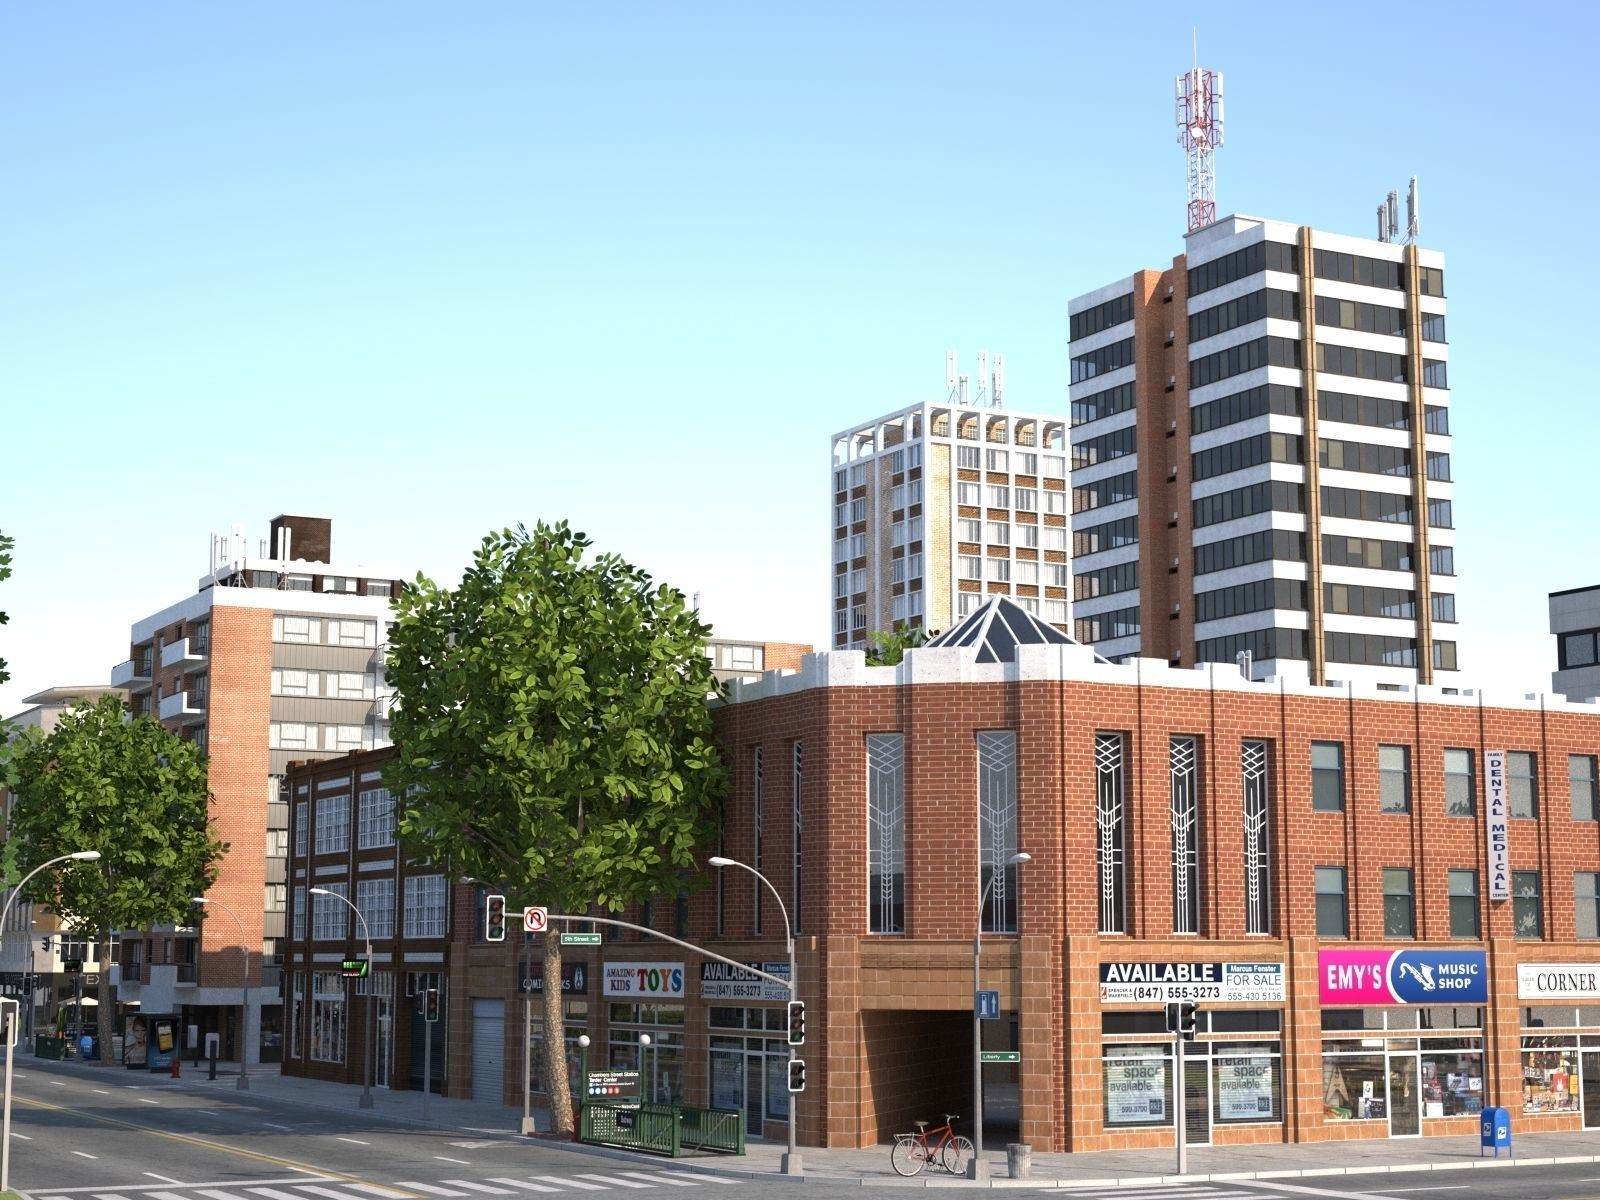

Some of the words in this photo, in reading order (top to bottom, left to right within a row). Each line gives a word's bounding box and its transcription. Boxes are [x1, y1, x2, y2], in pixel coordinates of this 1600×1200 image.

[1490, 760, 1503, 816] DENTAL
[1492, 824, 1506, 890] MEDICAL
[606, 968, 635, 978] AMAZING
[703, 963, 758, 981] AVAILABLE
[1106, 963, 1215, 982] AVAILABLE
[1230, 965, 1252, 973] Marcus
[1438, 964, 1478, 974] MUSIC
[636, 968, 682, 992] TOYS
[1226, 975, 1250, 986] FOR
[1253, 975, 1282, 986] SALE
[1327, 964, 1382, 990] EMY'S
[1537, 973, 1597, 991] CORNER
[610, 979, 631, 991] KIDS
[1438, 978, 1472, 989] SHOP
[1133, 987, 1164, 1001] (847)
[1167, 987, 1220, 998] 555-3273
[1227, 992, 1261, 1000] 555-430
[1262, 992, 1282, 1000] 5136
[1110, 1080, 1152, 1091] available
[1221, 1078, 1260, 1090] available
